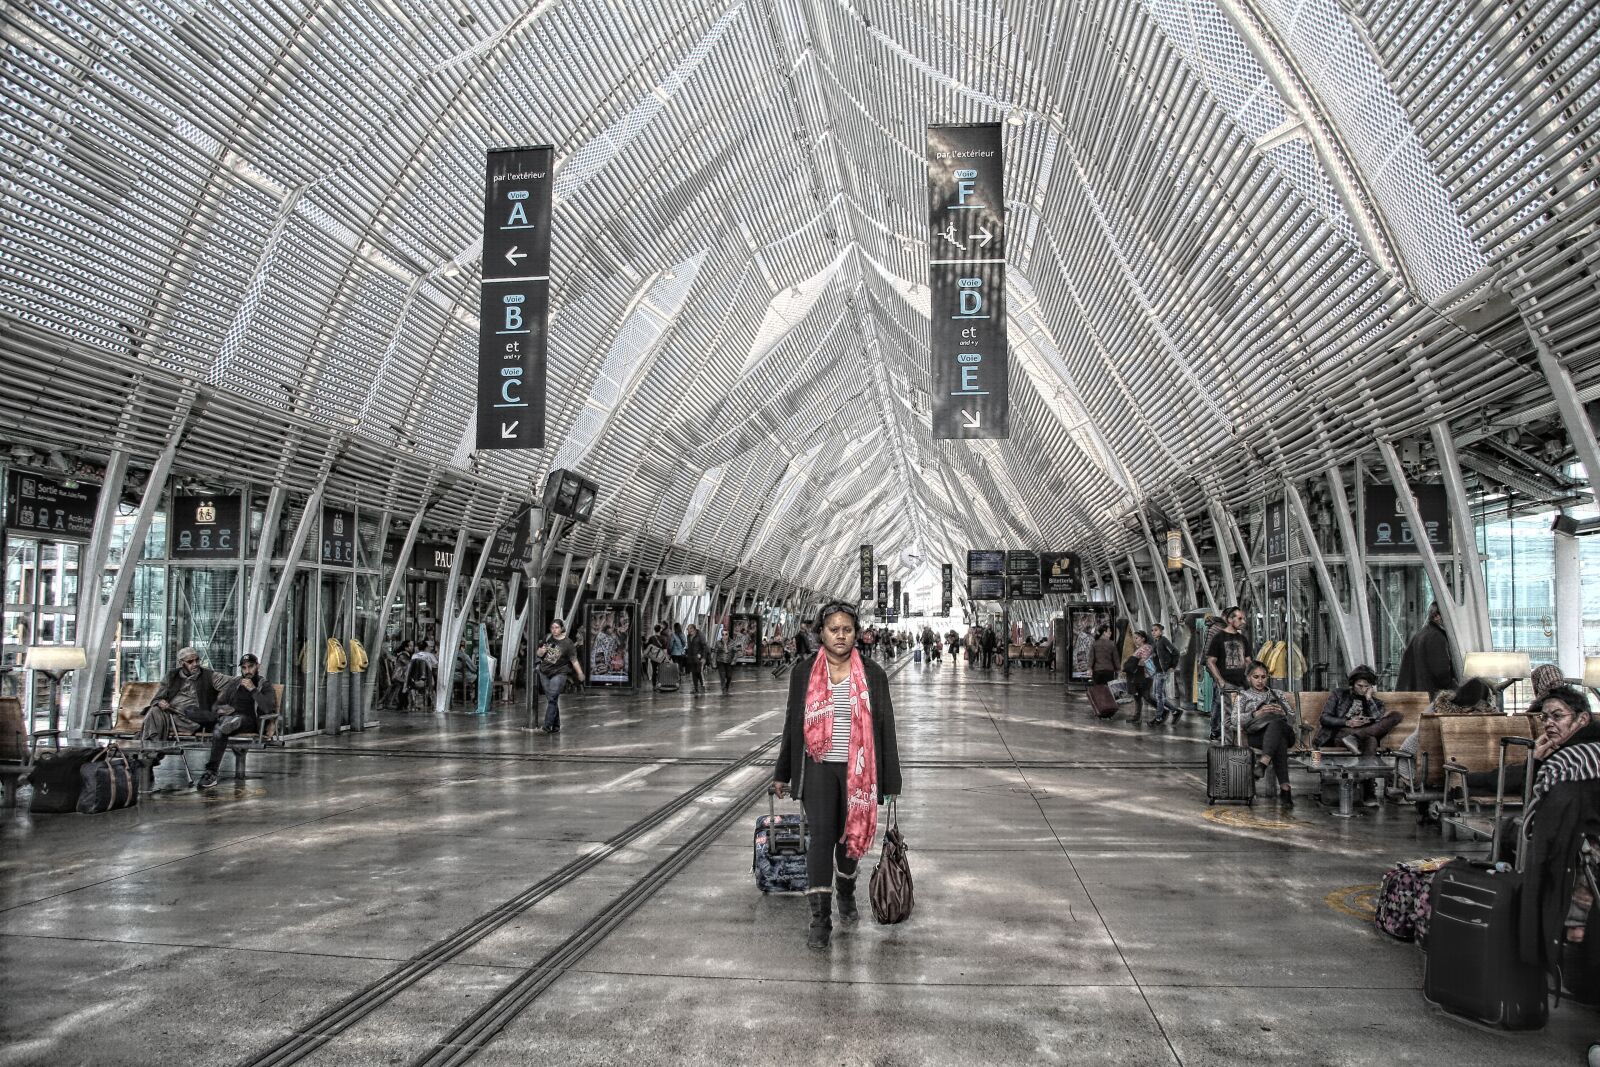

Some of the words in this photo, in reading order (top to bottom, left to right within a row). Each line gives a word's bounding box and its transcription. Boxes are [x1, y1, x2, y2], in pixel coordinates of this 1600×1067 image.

[494, 174, 506, 182] par
[508, 172, 546, 180] l'extérieur
[958, 181, 974, 204] F
[508, 202, 528, 224] A
[960, 290, 982, 314] D
[506, 306, 522, 330] B
[961, 326, 976, 338] et
[506, 341, 520, 352] et
[962, 366, 978, 390] E
[502, 379, 522, 402] C
[56, 516, 64, 528] A
[201, 536, 210, 548] B
[220, 536, 230, 548] C
[1402, 528, 1414, 542] D
[1427, 528, 1438, 542] E
[346, 548, 351, 560] C
[434, 550, 455, 568] PAU
